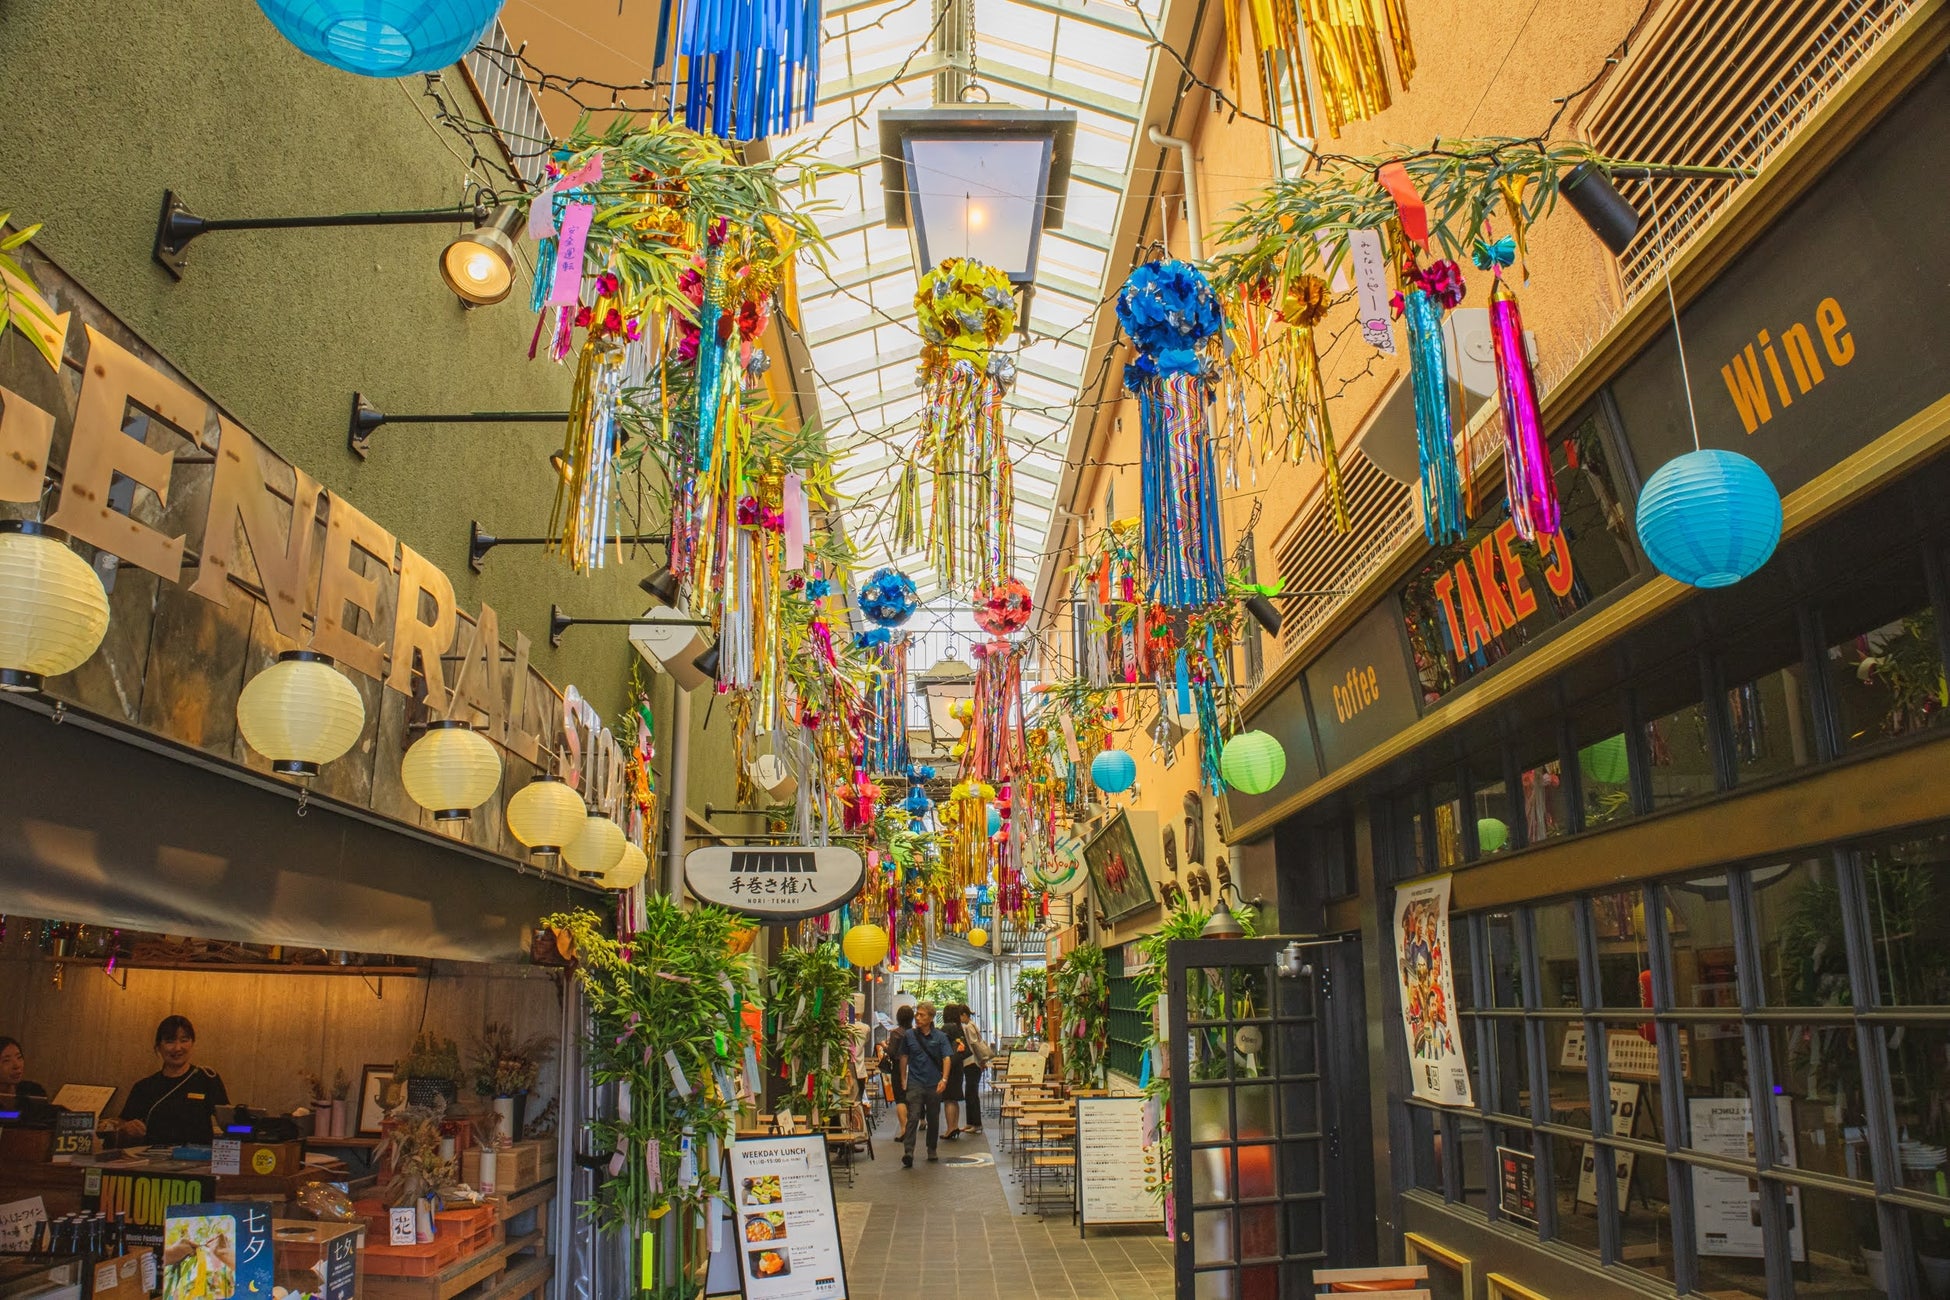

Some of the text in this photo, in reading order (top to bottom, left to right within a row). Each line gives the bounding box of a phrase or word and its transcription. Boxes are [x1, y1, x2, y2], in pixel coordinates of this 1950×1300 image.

[561, 224, 580, 272] 安全運転
[1720, 297, 1856, 435] Wine
[1434, 517, 1537, 663] TAKE
[1333, 665, 1379, 724] Coffee
[729, 876, 818, 895] 手巻き権八
[741, 1147, 806, 1159] WEEKDAY LUNCH
[242, 1208, 266, 1264] 七夕
[333, 1237, 352, 1261] 七夕
[395, 1216, 411, 1235] 花
